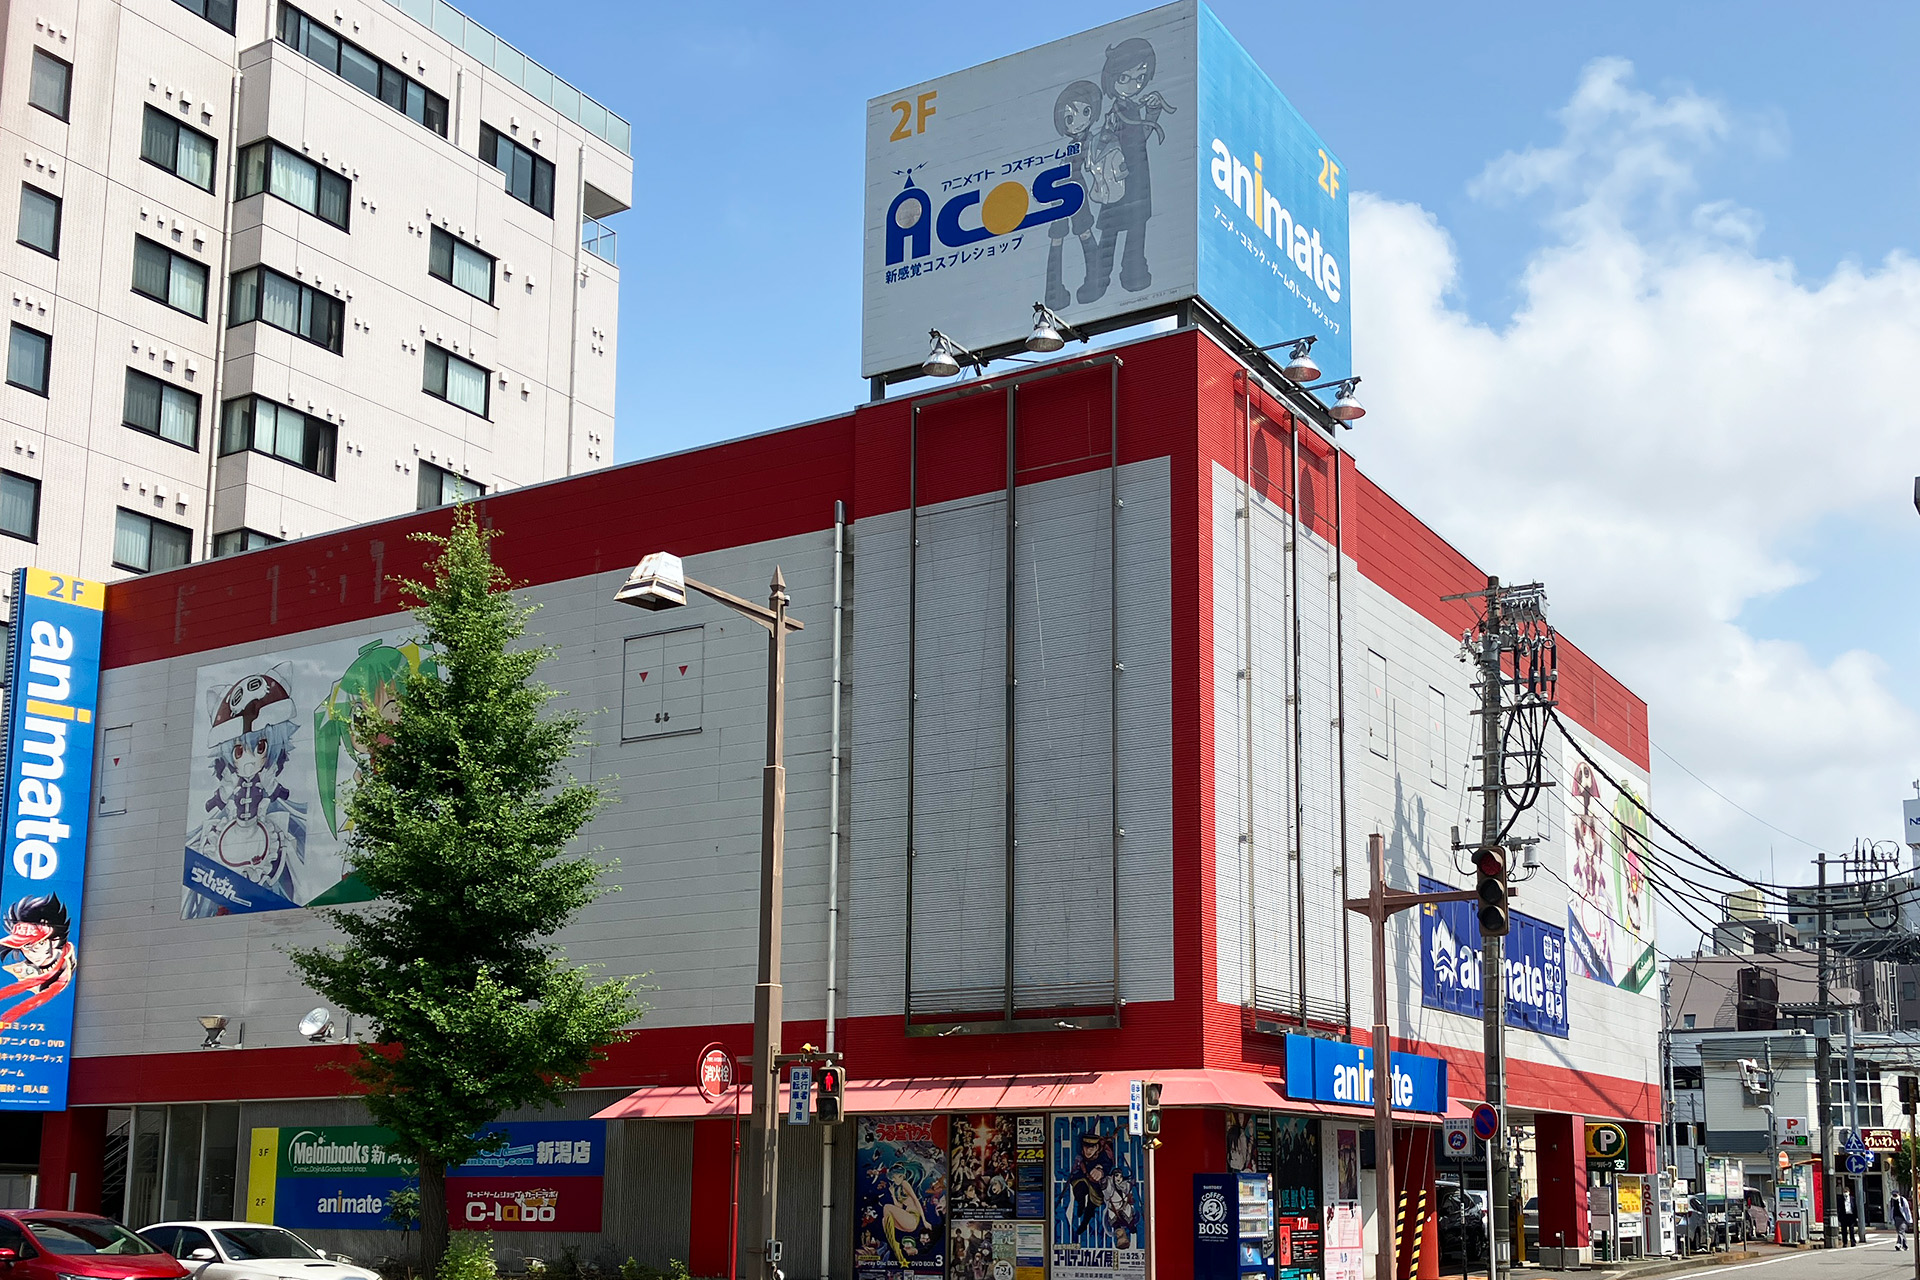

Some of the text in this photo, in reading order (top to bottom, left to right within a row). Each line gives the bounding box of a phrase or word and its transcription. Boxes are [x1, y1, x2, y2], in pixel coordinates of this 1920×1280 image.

[889, 90, 938, 142] 2F
[941, 142, 1081, 192] アニメイト コスチューム館
[1318, 148, 1340, 199] 2F
[1211, 137, 1341, 304] animate
[885, 234, 1024, 285] 新感覚コスプレショップ
[1213, 204, 1340, 336] アニメ・コミック・ゲームのトータルショップ
[47, 575, 85, 601] 2F
[12, 620, 92, 881] animate
[704, 1065, 730, 1082] 消火栓
[791, 1071, 800, 1100] 自転車
[800, 1071, 809, 1100] 歩行者
[876, 1122, 932, 1142] うる星やつら
[1018, 1127, 1042, 1135] スライム
[1786, 1119, 1799, 1129] P
[536, 1140, 591, 1164] 新潟店
[1600, 1129, 1617, 1151] P
[258, 1149, 269, 1157] 3F
[294, 1141, 369, 1165] Melonbooks
[1016, 1149, 1044, 1159] 7.24
[255, 1198, 266, 1206] 2F
[317, 1190, 382, 1214] animate
[1201, 1191, 1225, 1202] COFFEE
[1643, 1184, 1654, 1216] DyDo
[465, 1201, 556, 1222] C-labo
[1786, 1211, 1800, 1219] 入口
[1198, 1222, 1229, 1235] BOSS
[935, 1254, 944, 1267] 3
